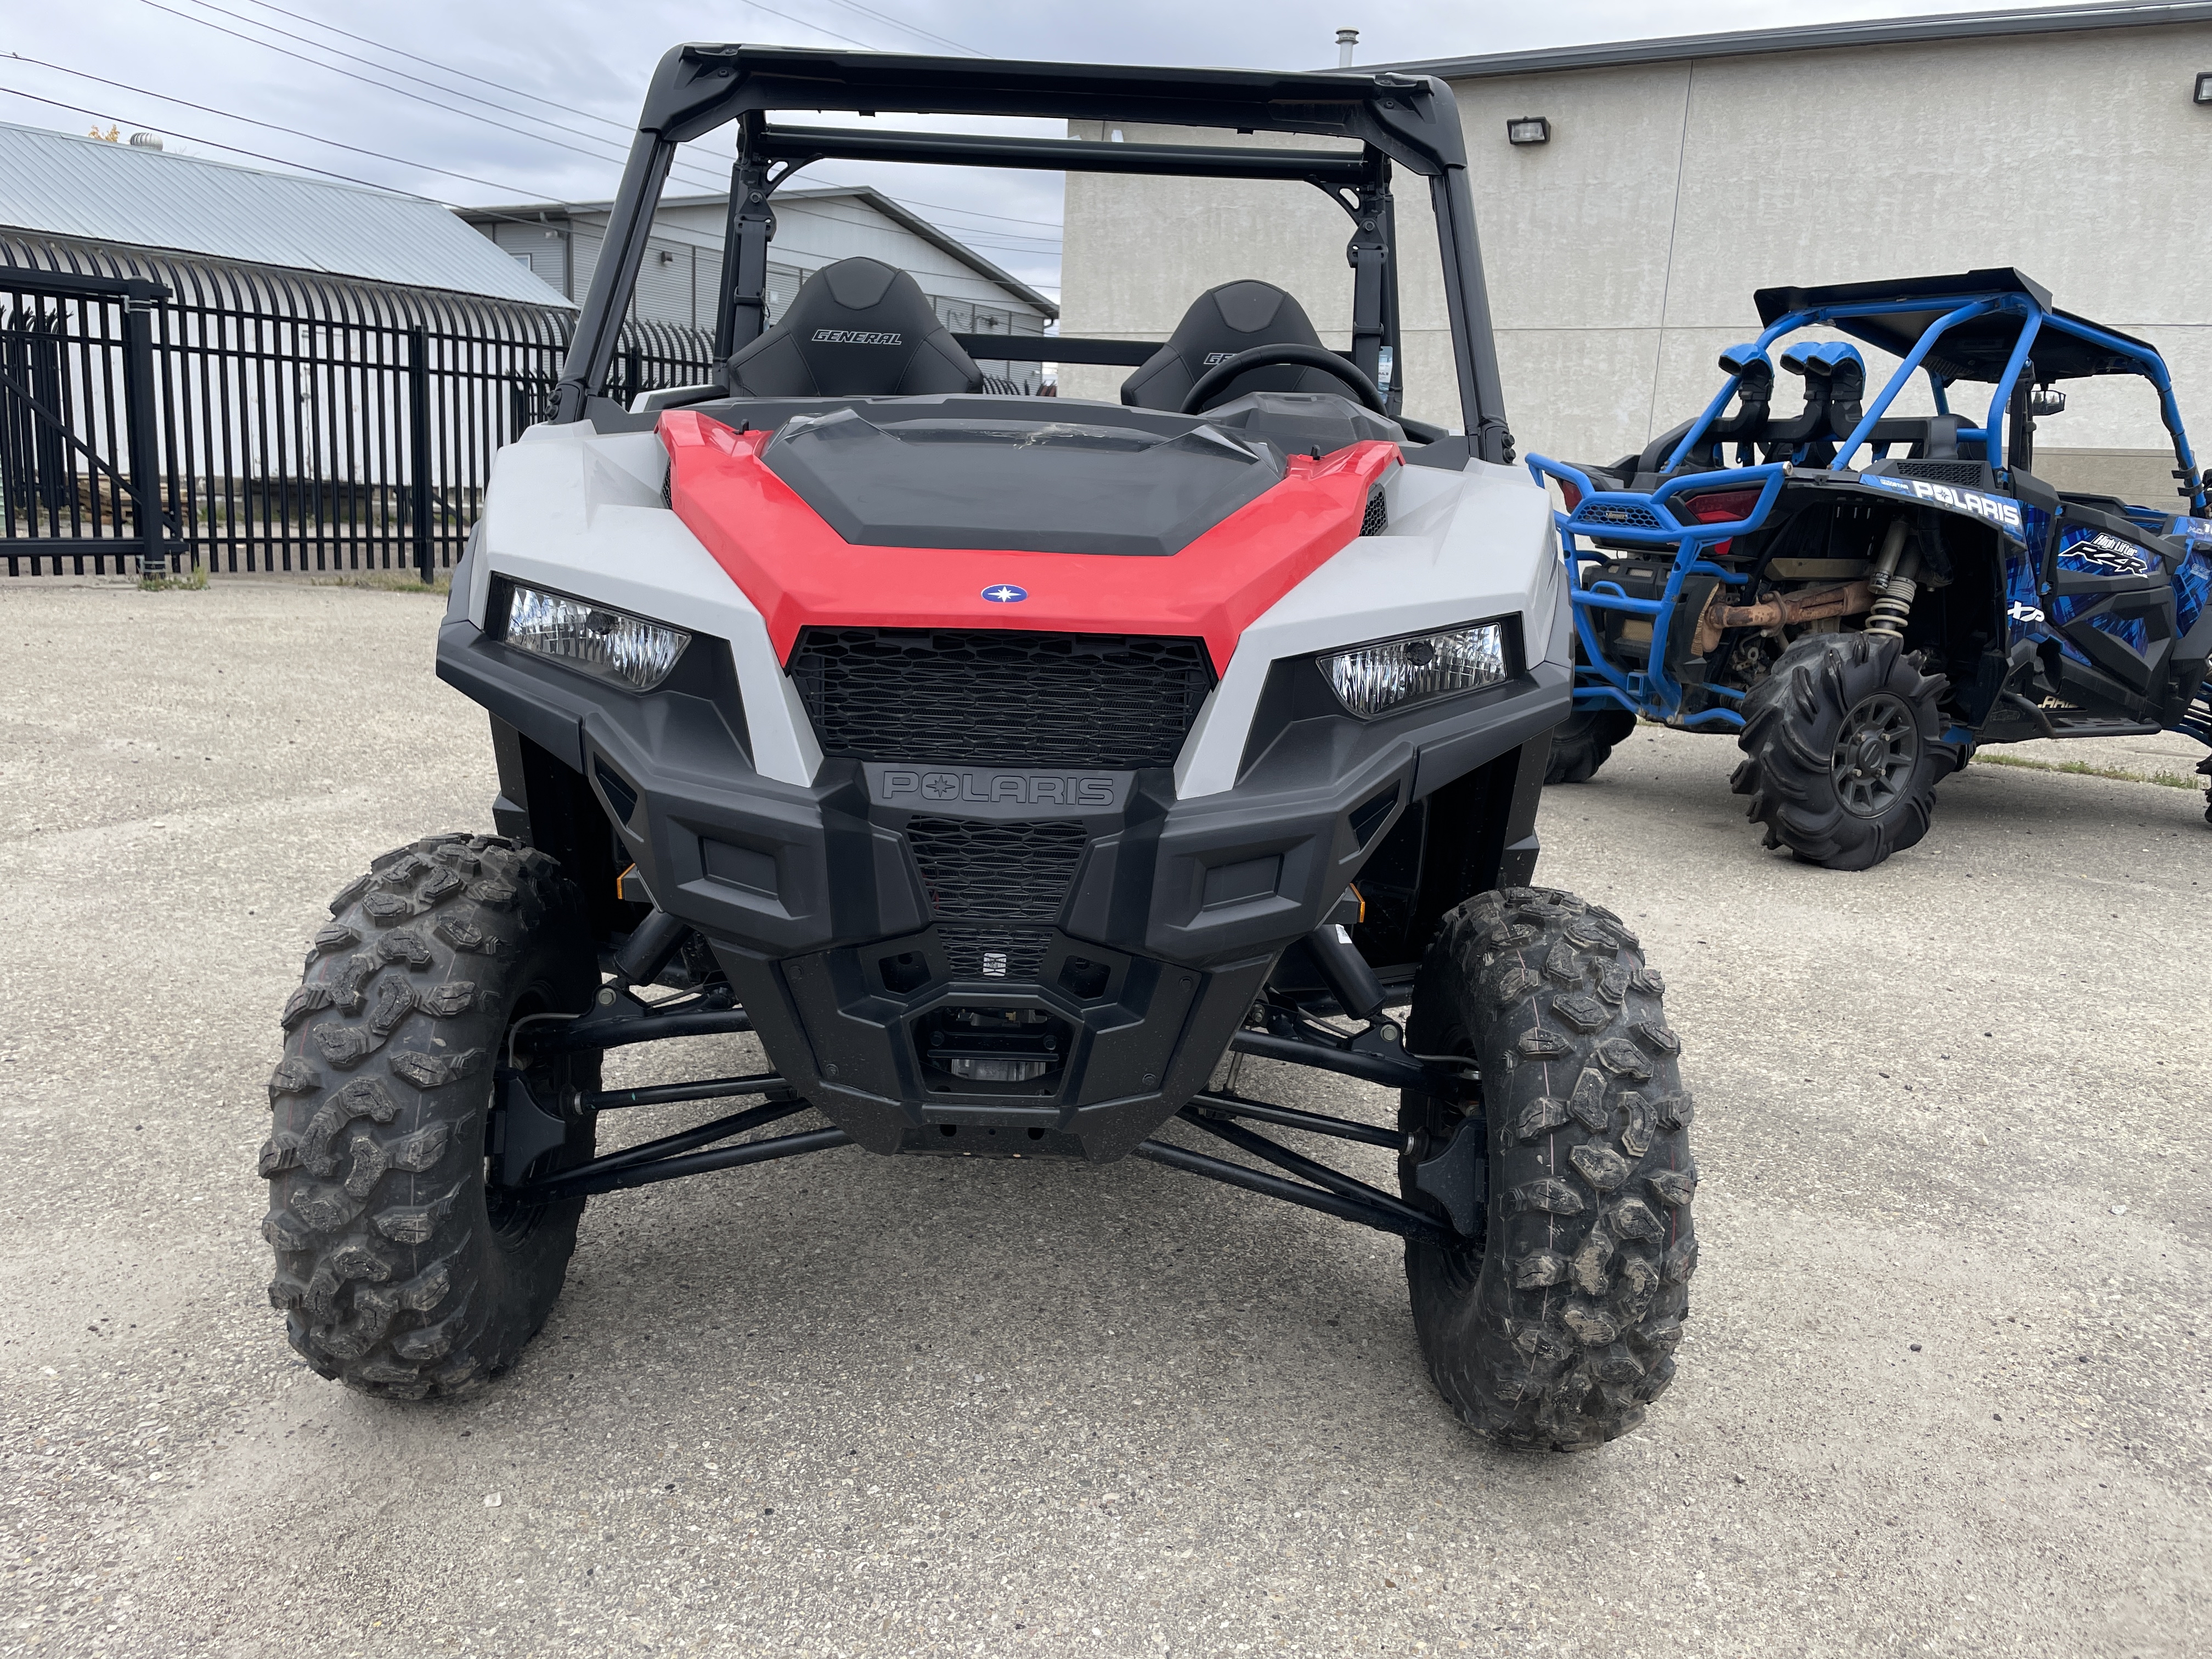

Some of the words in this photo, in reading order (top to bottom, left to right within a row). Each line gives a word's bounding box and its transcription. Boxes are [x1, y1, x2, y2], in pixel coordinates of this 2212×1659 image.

[811, 329, 902, 345] GENERAL
[1912, 481, 2020, 526] POLARIS
[2093, 534, 2116, 549] High
[2113, 541, 2138, 556] Lifter
[2007, 600, 2045, 622] XP
[882, 770, 1114, 806] POLARIS
